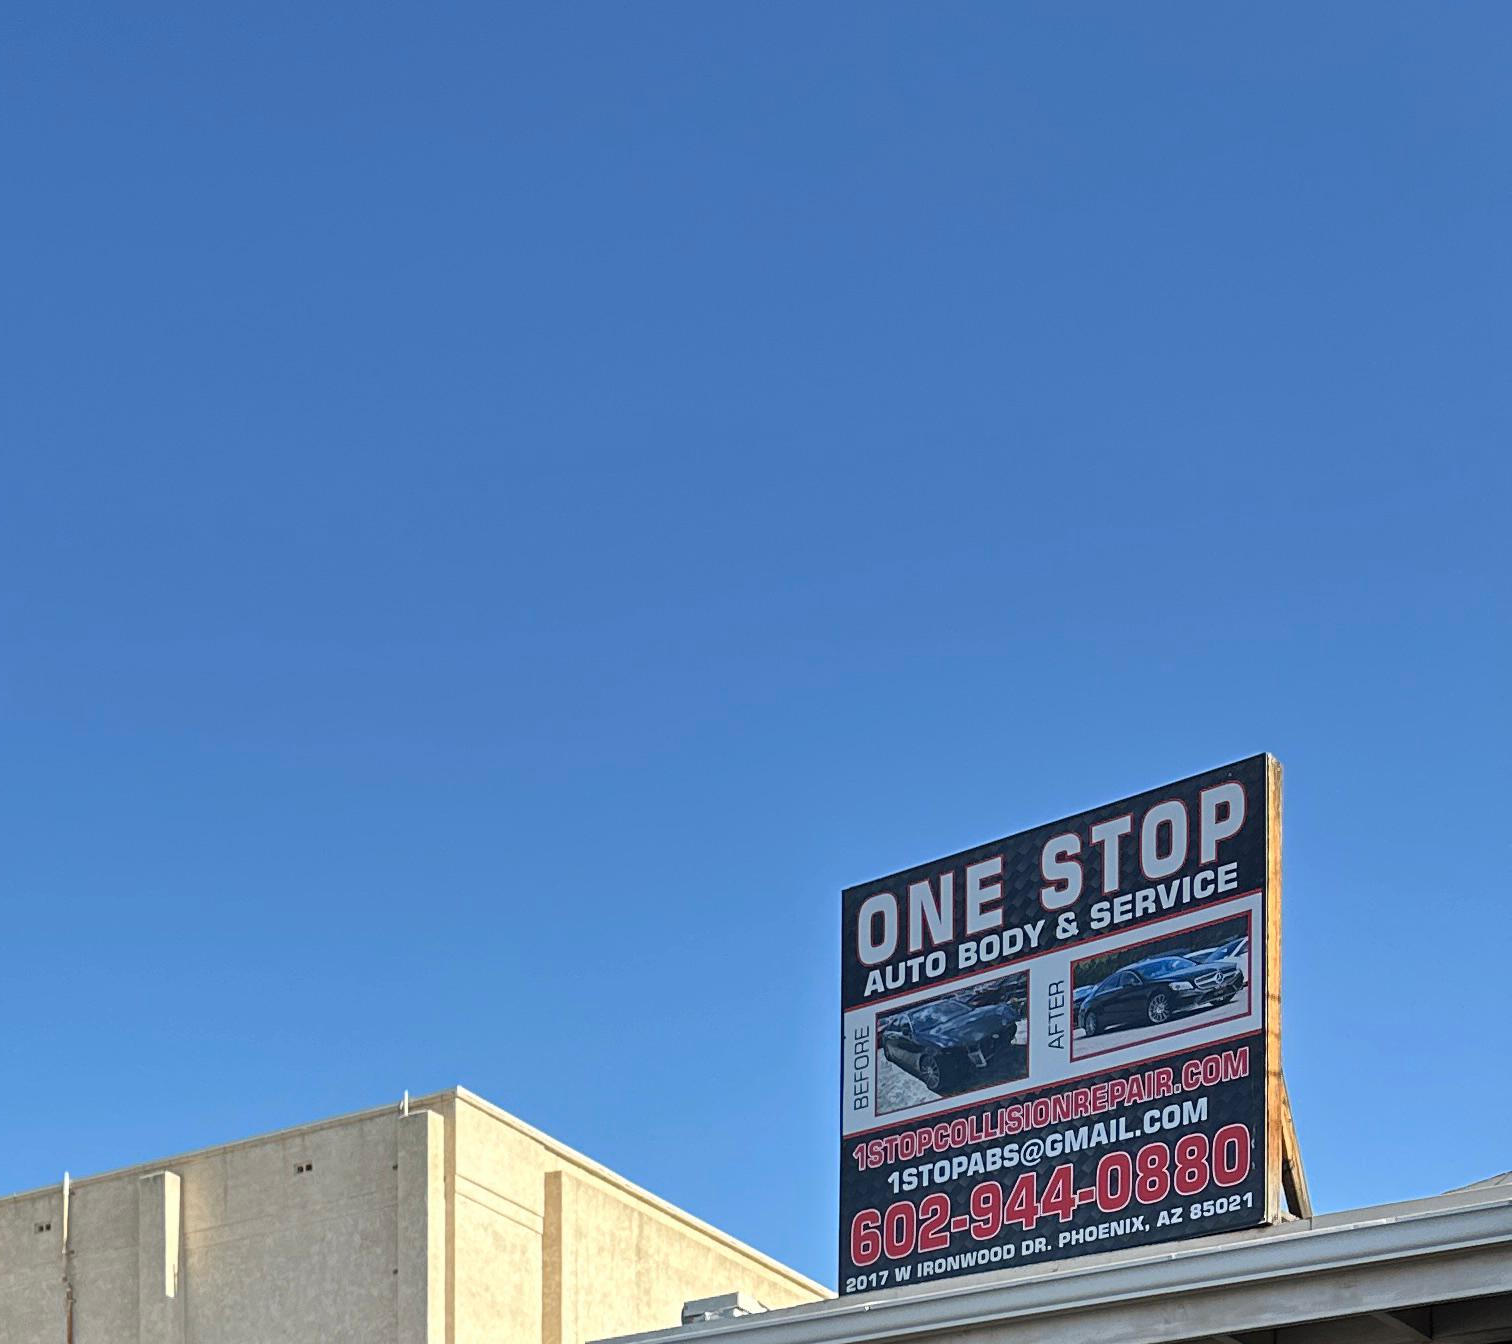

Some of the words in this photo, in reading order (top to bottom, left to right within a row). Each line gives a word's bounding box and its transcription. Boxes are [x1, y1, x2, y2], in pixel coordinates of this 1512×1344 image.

[857, 856, 1003, 966] ONE
[1041, 781, 1246, 911] STOP
[863, 950, 947, 997] AUTO
[958, 920, 1045, 970] BODY
[1055, 911, 1079, 940] &
[1090, 862, 1238, 930] SERVICE
[853, 1025, 870, 1111] BEFORE
[1048, 980, 1065, 1050] AFTER
[852, 1047, 1250, 1171] 1STOPCOLLISIONREPAIR.COM
[887, 1097, 1209, 1194] 1STOPABS@GMAIL.COM
[846, 1271, 889, 1293] 2017
[895, 1265, 912, 1282] W
[917, 1243, 1015, 1279] IRONWOOD
[1021, 1237, 1052, 1256] DR.
[1059, 1215, 1150, 1249] PHOENIX,
[1156, 1210, 1183, 1228] AZ
[1190, 1191, 1253, 1221] 85021
[850, 1123, 1251, 1267] 602-944-0880
